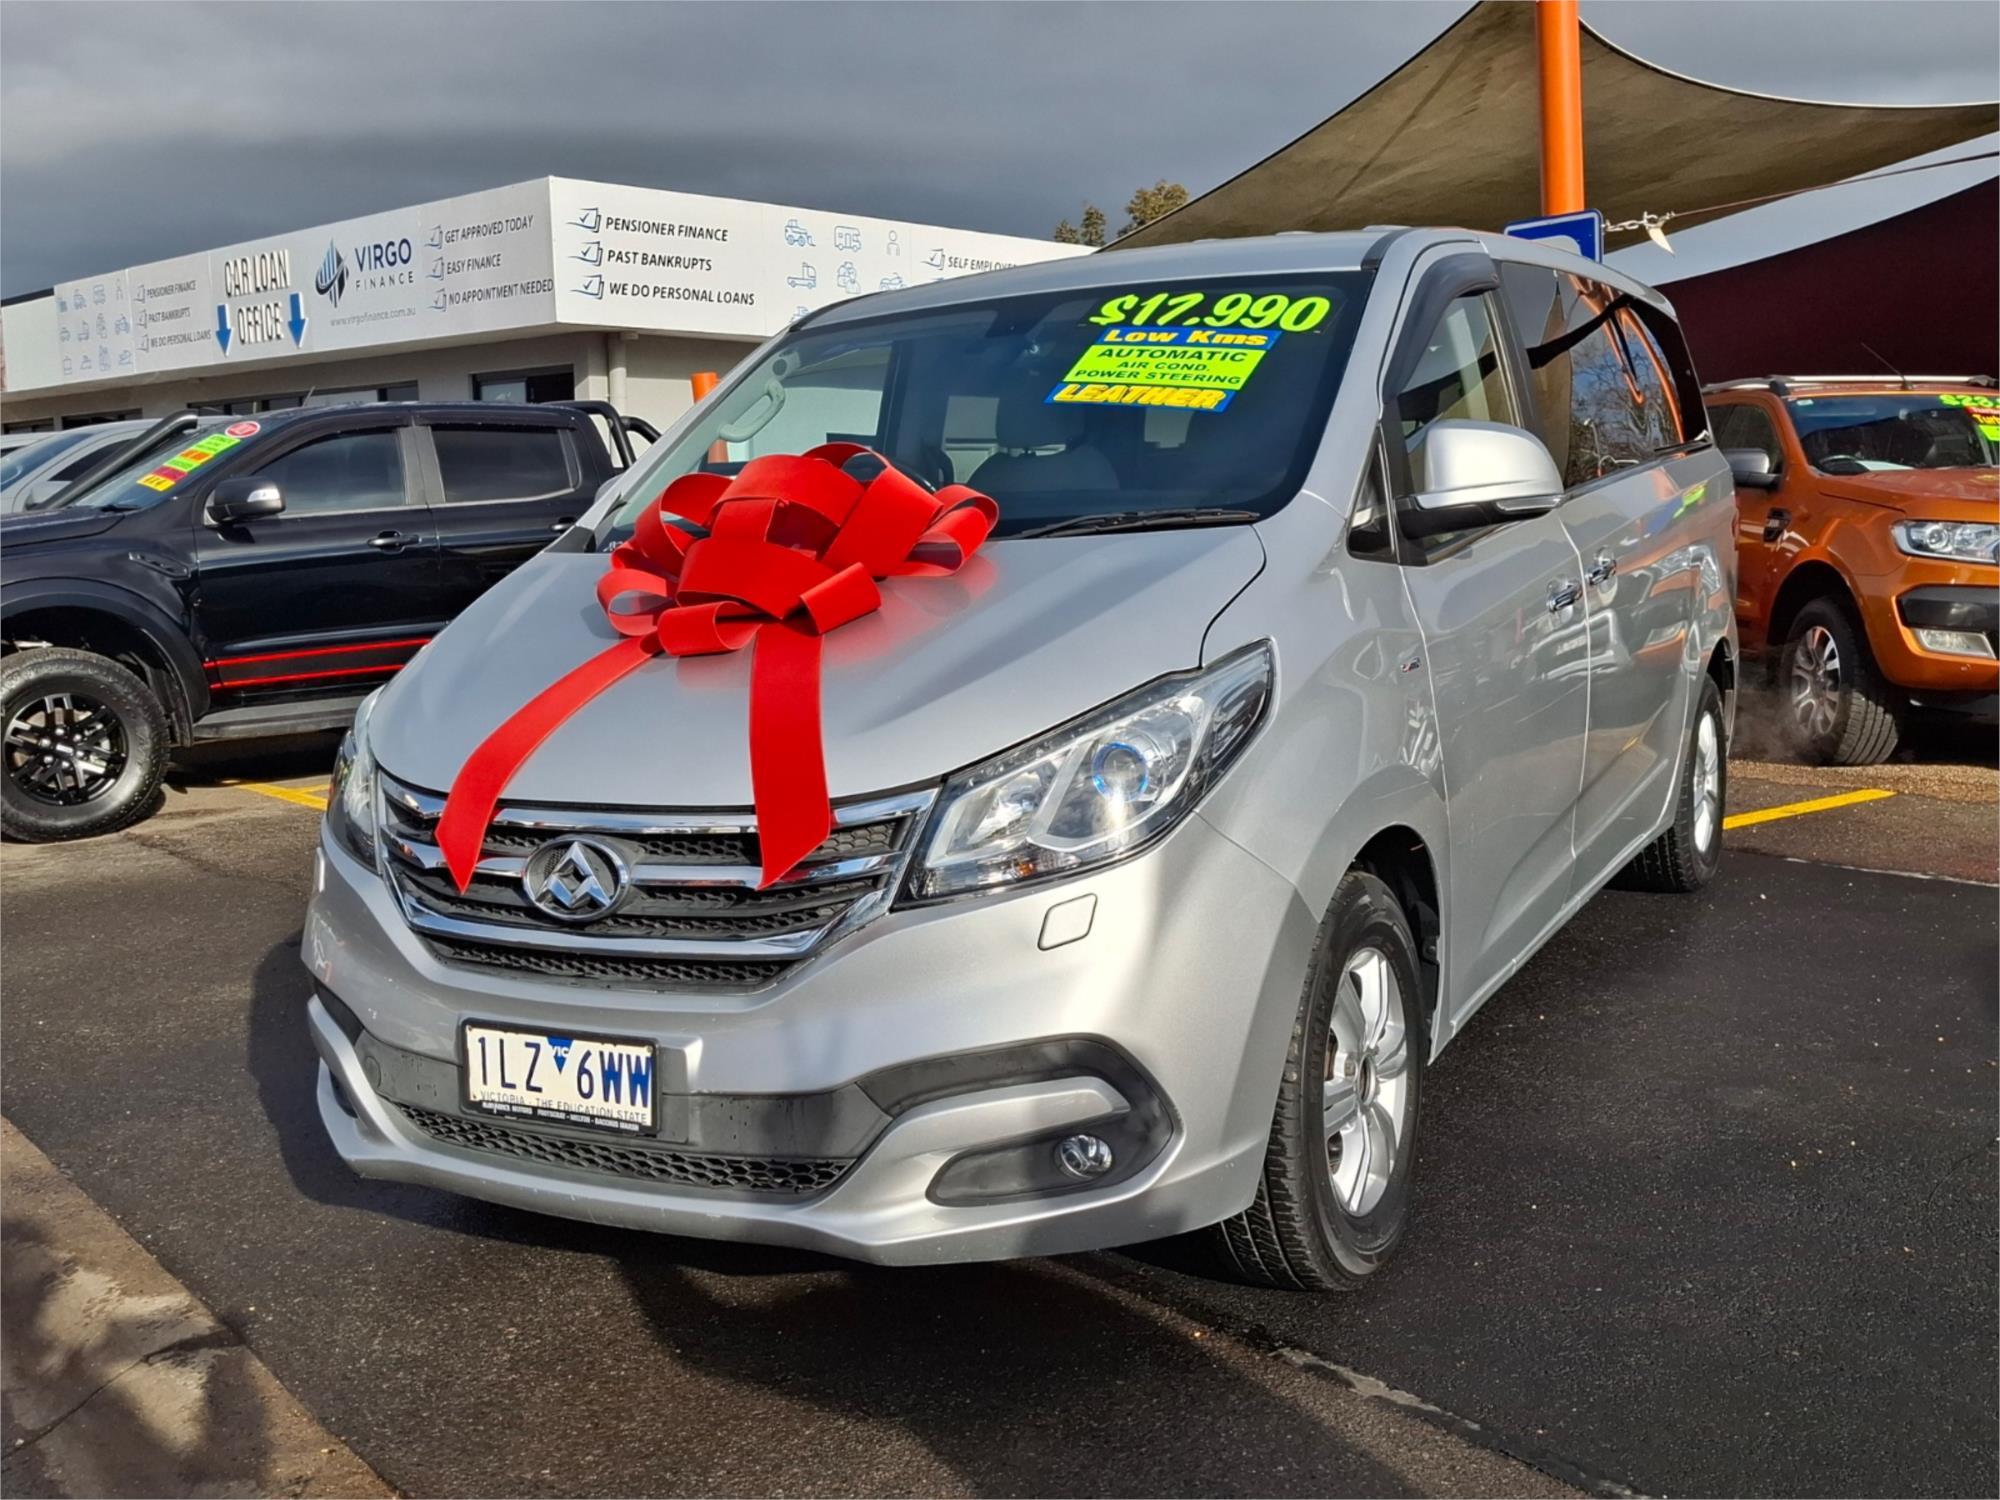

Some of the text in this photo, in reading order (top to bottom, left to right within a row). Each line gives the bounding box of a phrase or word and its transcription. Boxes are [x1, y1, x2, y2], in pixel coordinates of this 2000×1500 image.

[444, 214, 534, 243] GET APPROVED TODAY
[606, 216, 728, 242] PENSIONER FINANCE
[354, 237, 412, 272] VIRGO
[446, 253, 502, 275] EASY FINANCE
[607, 249, 712, 271] PAST BANKRUPTS
[947, 255, 970, 269] SELF
[224, 248, 291, 298] CAR LOAN
[355, 270, 415, 291] FINANCE
[448, 278, 555, 306] NO APPOINTMENT NEEDED
[609, 281, 756, 306] WE DO PERSONAL LOANS
[237, 301, 285, 345] OFFICE
[1103, 328, 1269, 346] Low Kms
[1097, 348, 1248, 363] AUTOMATIC
[1116, 360, 1211, 372] AIR COND.
[1074, 368, 1242, 384] POWER STEERING
[1052, 383, 1227, 409] LEATHER
[477, 1036, 652, 1109] 1LZ 6WW
[480, 1091, 526, 1105] VICTORIA
[536, 1097, 554, 1109] THE
[557, 1100, 614, 1118] EDUCATION
[617, 1108, 648, 1124] STATE
